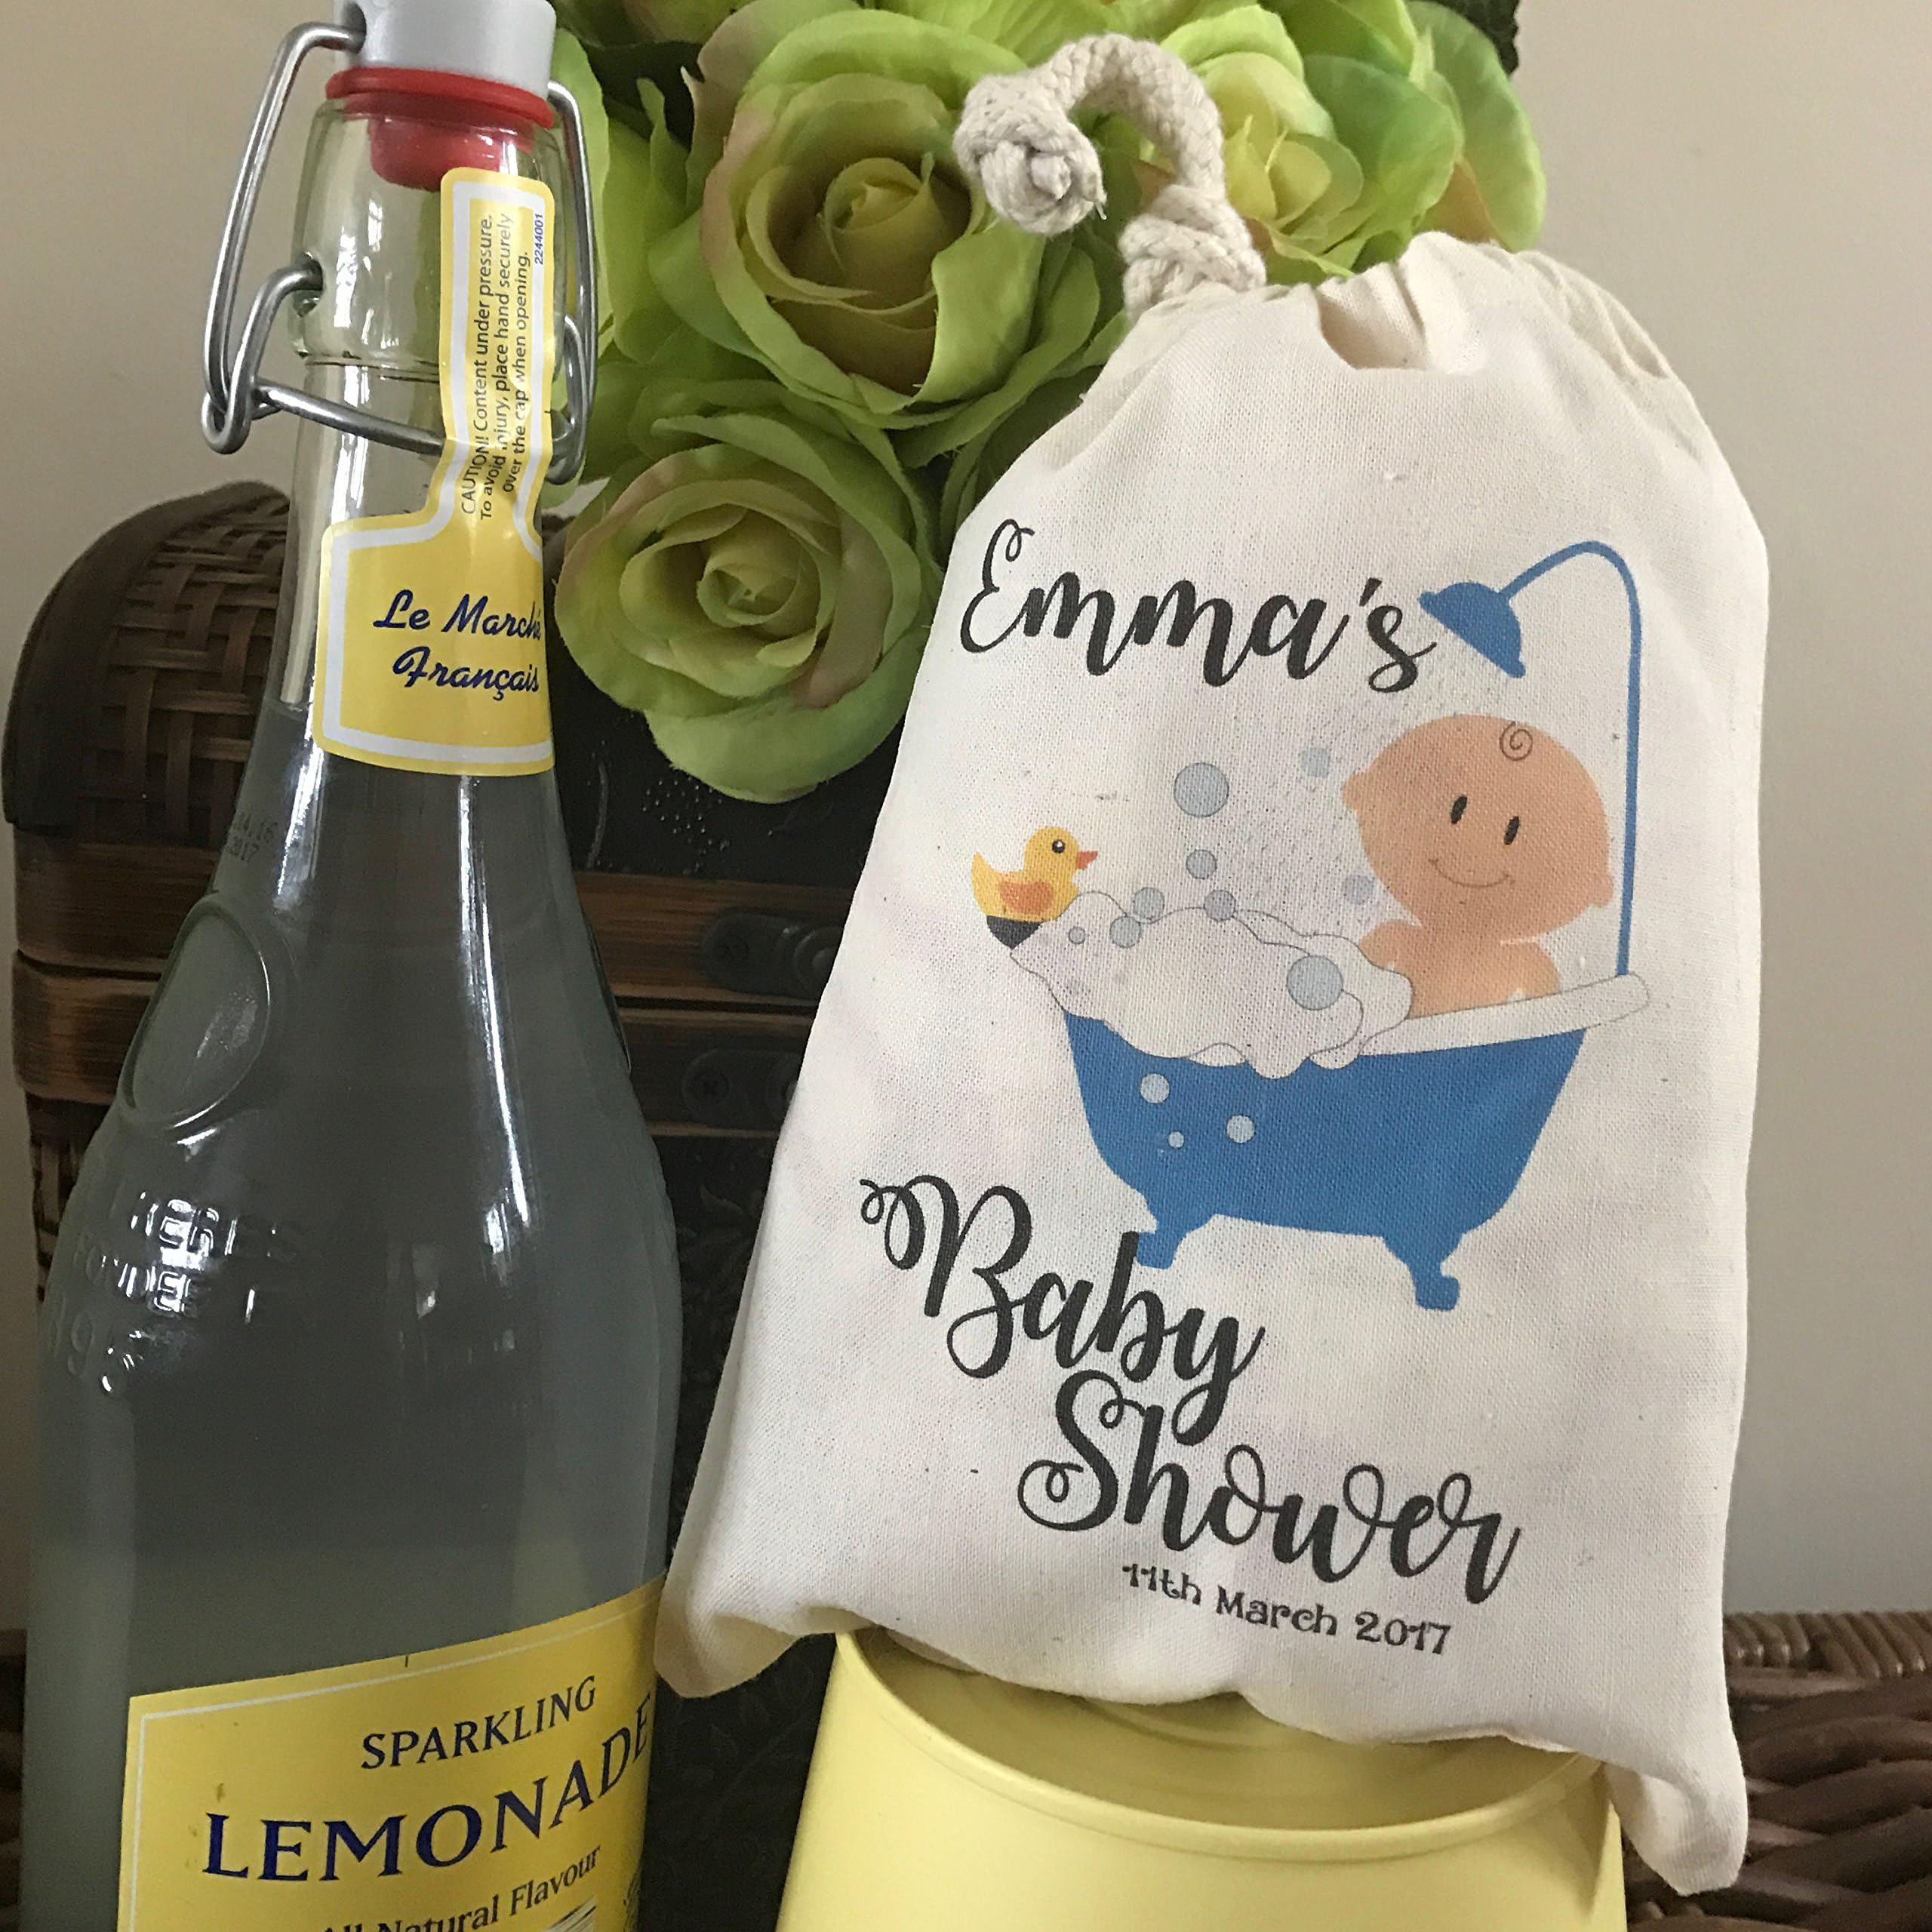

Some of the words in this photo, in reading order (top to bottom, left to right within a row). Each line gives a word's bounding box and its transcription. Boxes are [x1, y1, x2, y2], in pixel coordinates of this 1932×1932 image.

[478, 215, 494, 297] pressure.
[497, 213, 514, 287] securely
[534, 214, 543, 265] 2244001
[494, 293, 509, 338] hand
[515, 251, 531, 330] opening.
[473, 300, 491, 355] under
[491, 344, 510, 391] place
[512, 336, 525, 383] when
[473, 359, 488, 431] Content
[515, 389, 529, 420] cap
[494, 397, 511, 451] injury,
[512, 425, 525, 454] the
[461, 436, 489, 514] CAUTION!
[484, 455, 506, 496] avoid
[503, 459, 522, 492] over
[481, 501, 492, 521] To
[373, 589, 430, 629] Le
[960, 518, 1436, 693] Emma's
[392, 645, 539, 701] Français
[860, 1174, 1266, 1445] Baby
[1017, 1369, 1521, 1604] Shower
[1121, 1563, 1202, 1605] 11th
[1215, 1585, 1338, 1636] March
[1355, 1611, 1451, 1654] 2017
[361, 1675, 595, 1769] SPARKLING
[202, 1692, 651, 1881] LEMONADE
[509, 1844, 601, 1916] Flavour
